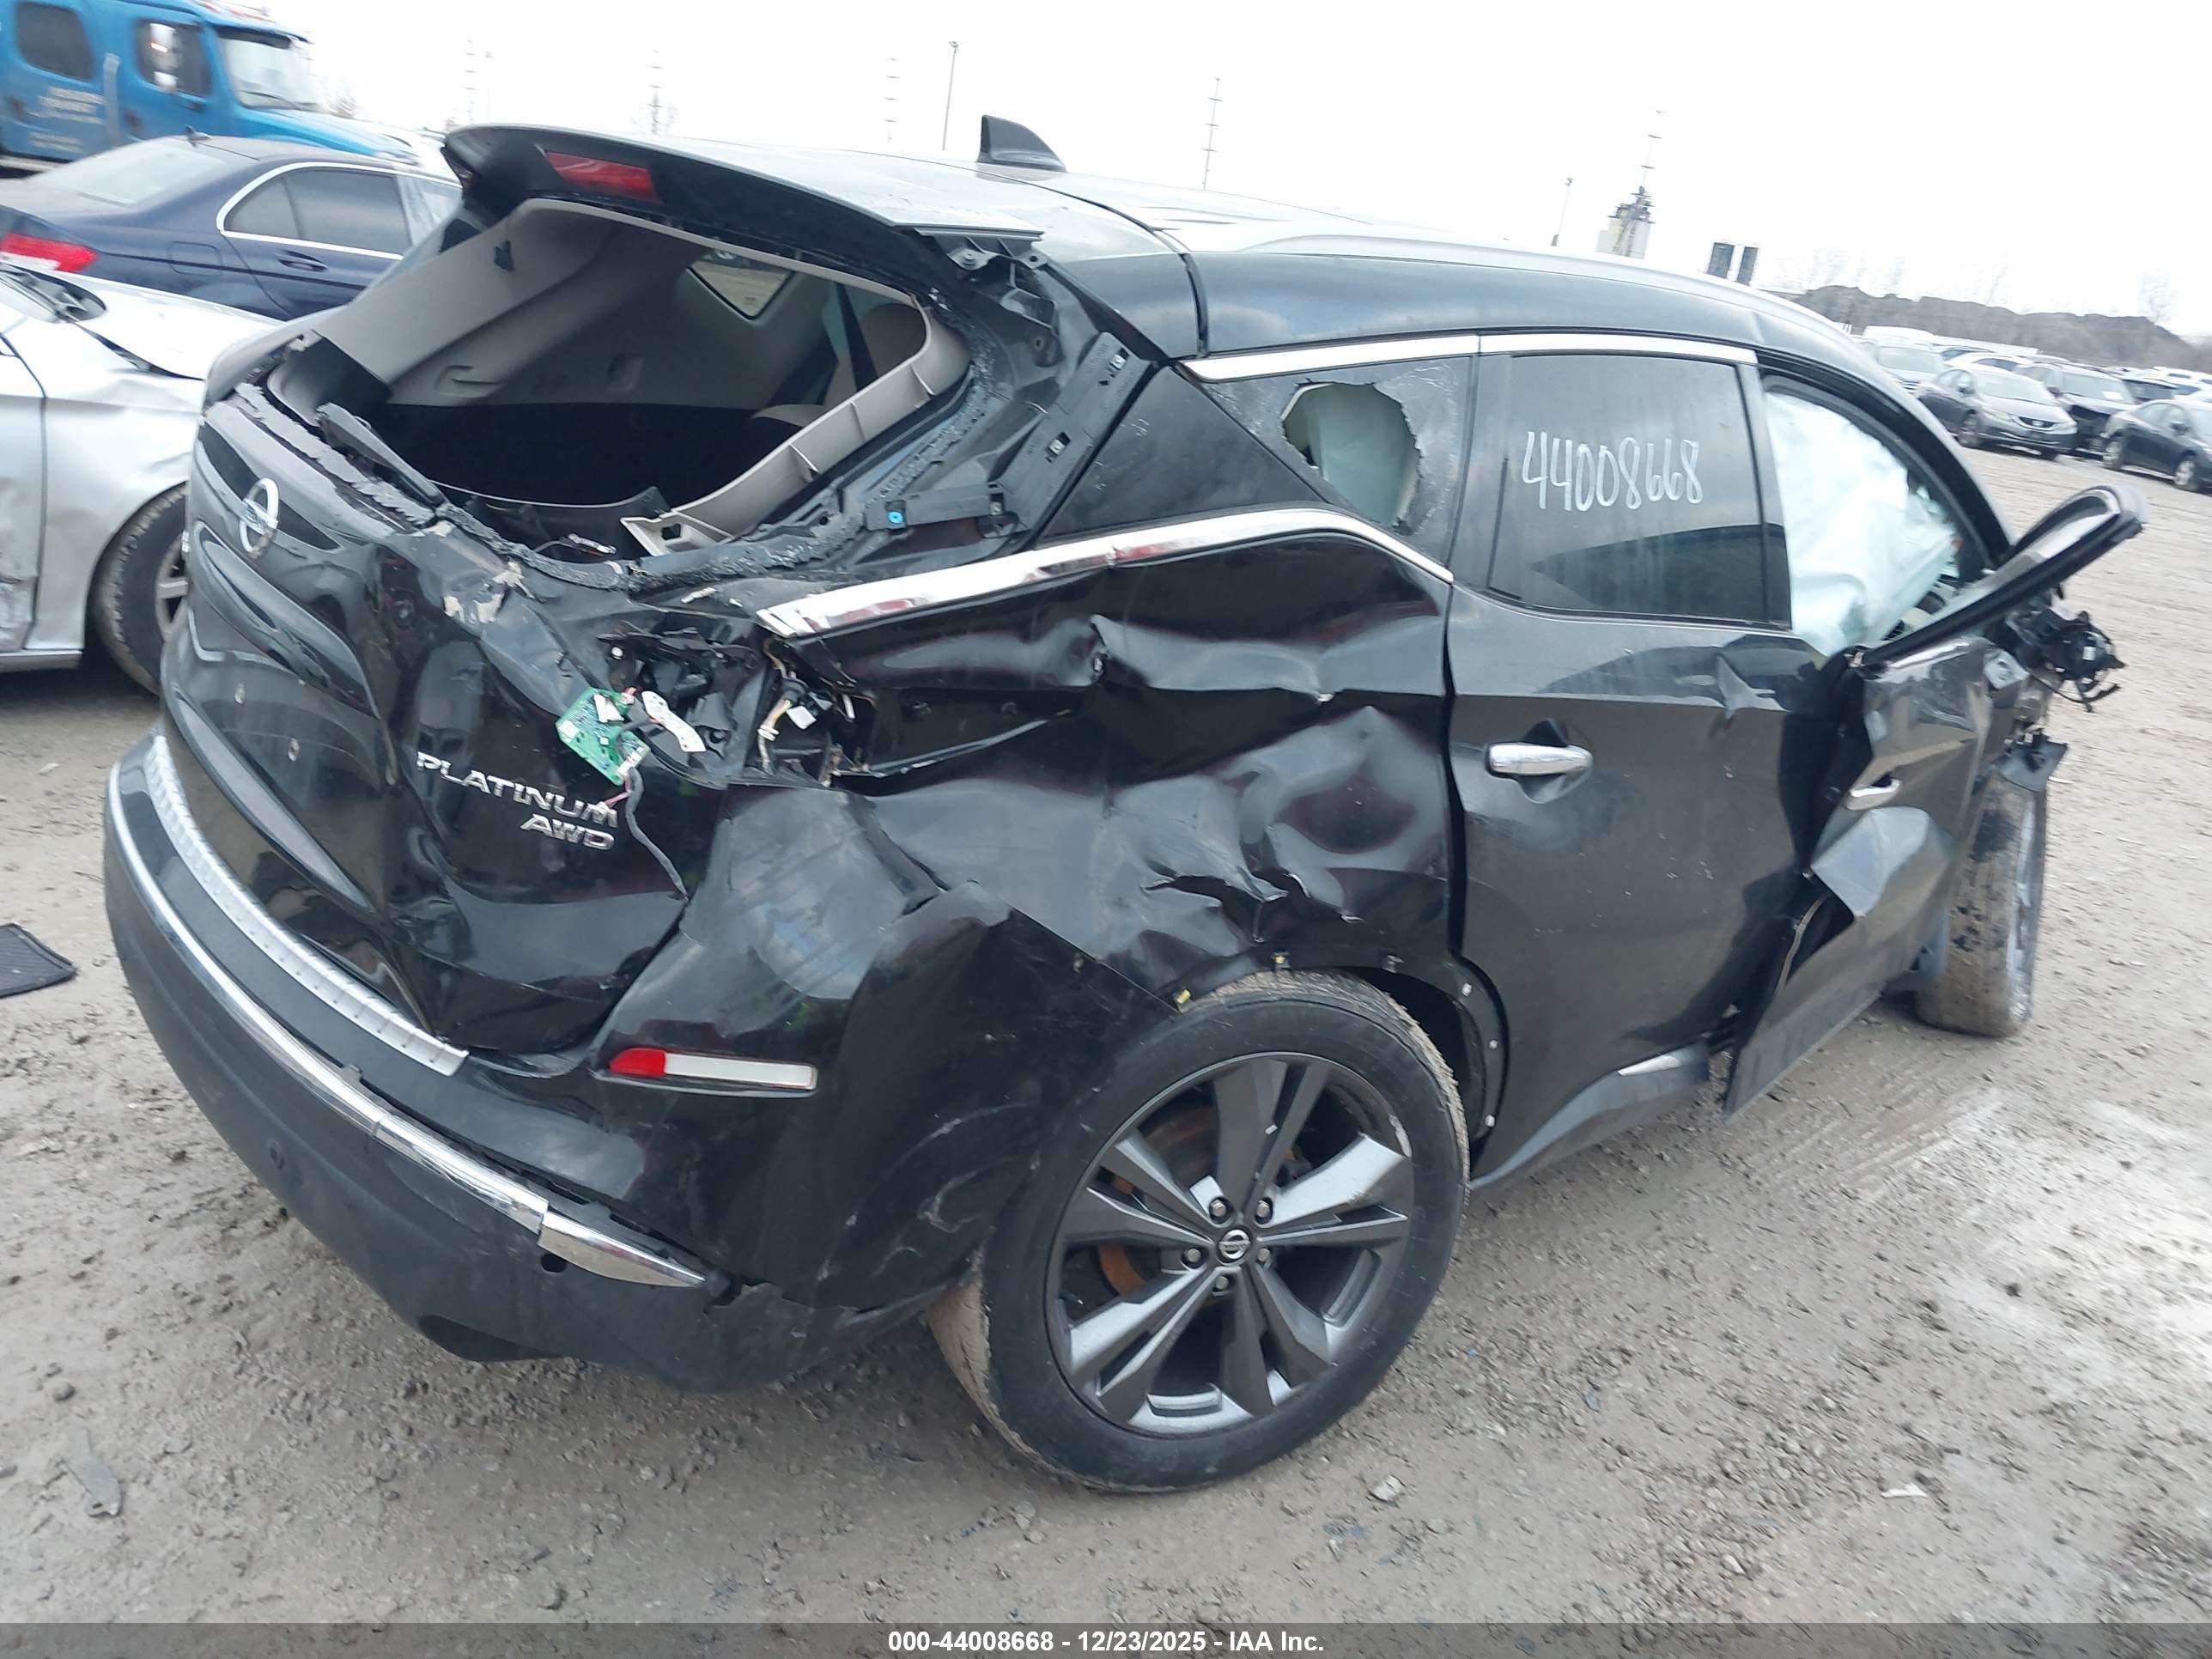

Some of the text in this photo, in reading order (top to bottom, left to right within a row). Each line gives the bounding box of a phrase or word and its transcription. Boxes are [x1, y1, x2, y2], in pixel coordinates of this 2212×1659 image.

[1522, 431, 1704, 511] 44008668
[416, 750, 618, 828] PLATINUM
[520, 812, 616, 851] AWD
